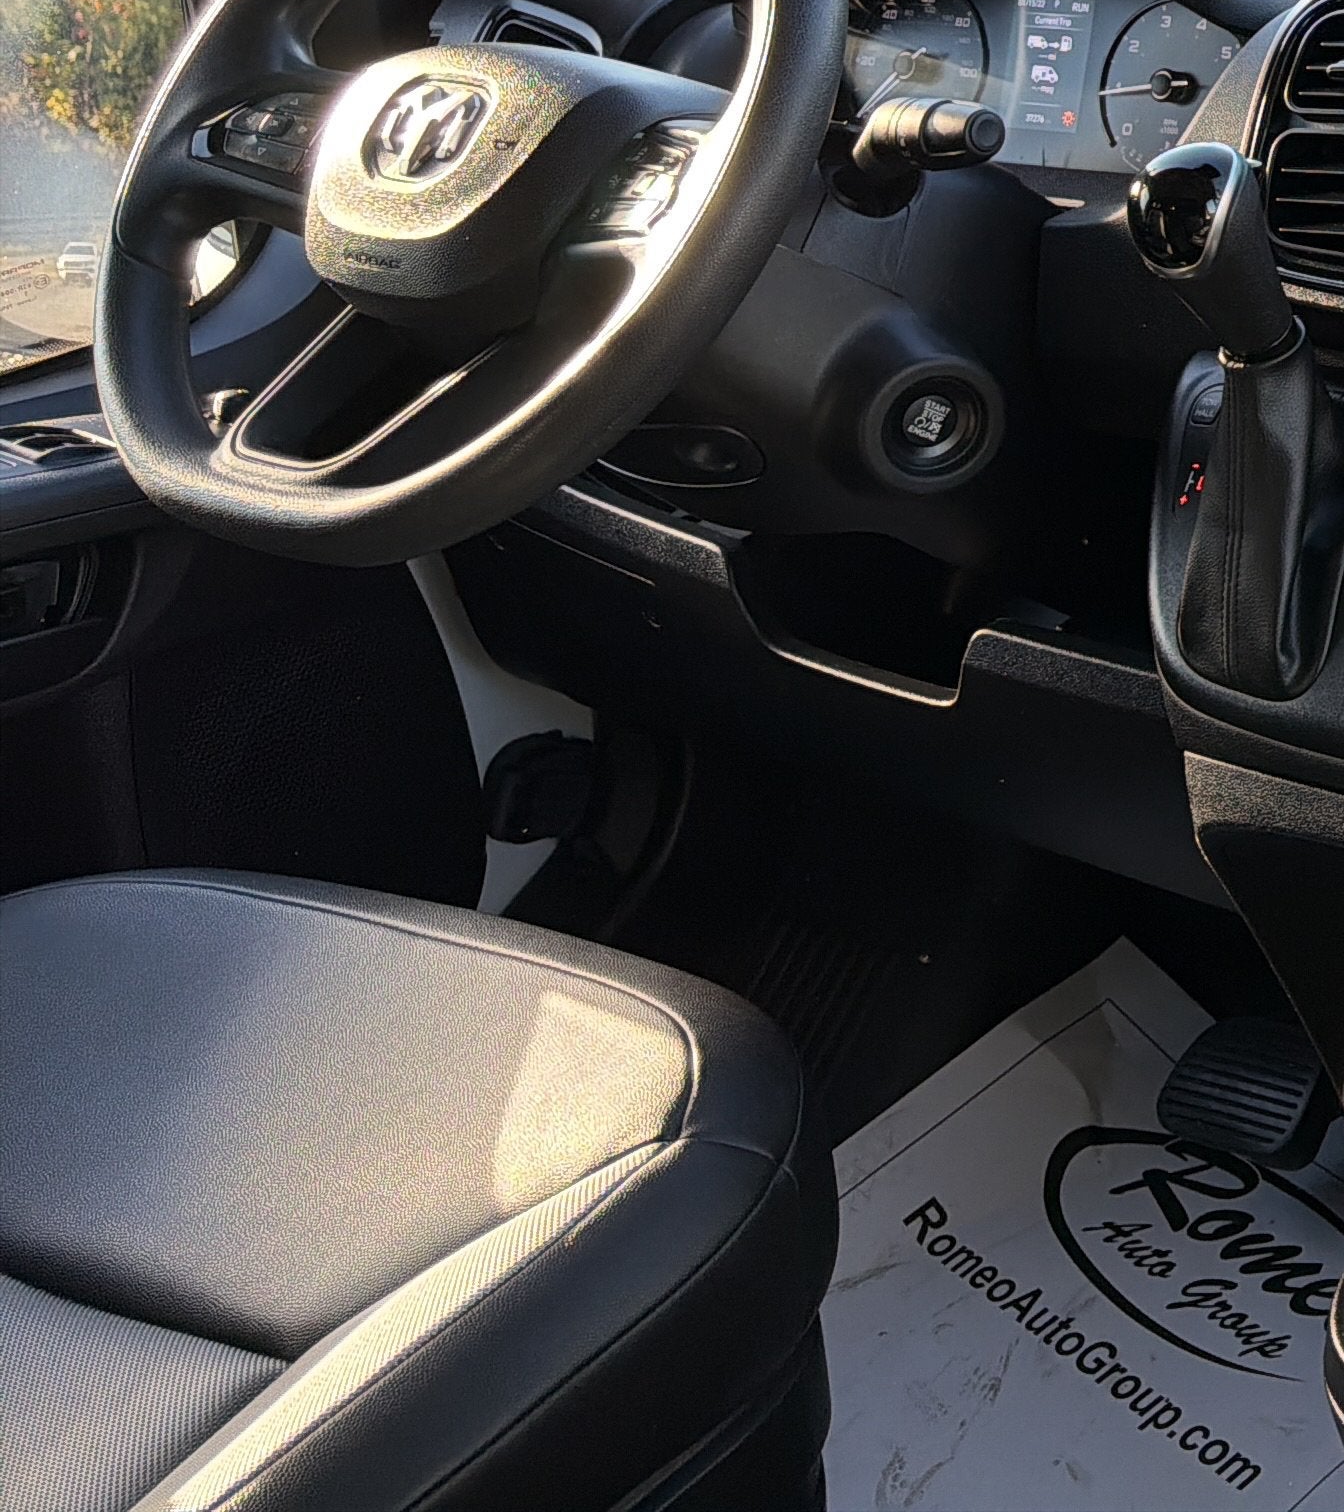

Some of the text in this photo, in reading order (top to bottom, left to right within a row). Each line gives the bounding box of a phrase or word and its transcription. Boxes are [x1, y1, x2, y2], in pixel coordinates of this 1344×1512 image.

[1072, 2, 1090, 13] RUN
[1160, 15, 1172, 28] 3
[1195, 18, 1208, 31] 4
[1128, 39, 1140, 53] 2
[1221, 46, 1232, 59] 5
[1122, 123, 1133, 136] 0
[924, 399, 951, 415] START
[921, 409, 945, 422] STOP
[907, 424, 939, 442] ENGINE
[1108, 1139, 1338, 1316] Rome
[1081, 1221, 1177, 1279] Auto
[1165, 1278, 1293, 1359] Group
[902, 1196, 1262, 1491] RomeoAutoGroup.com
